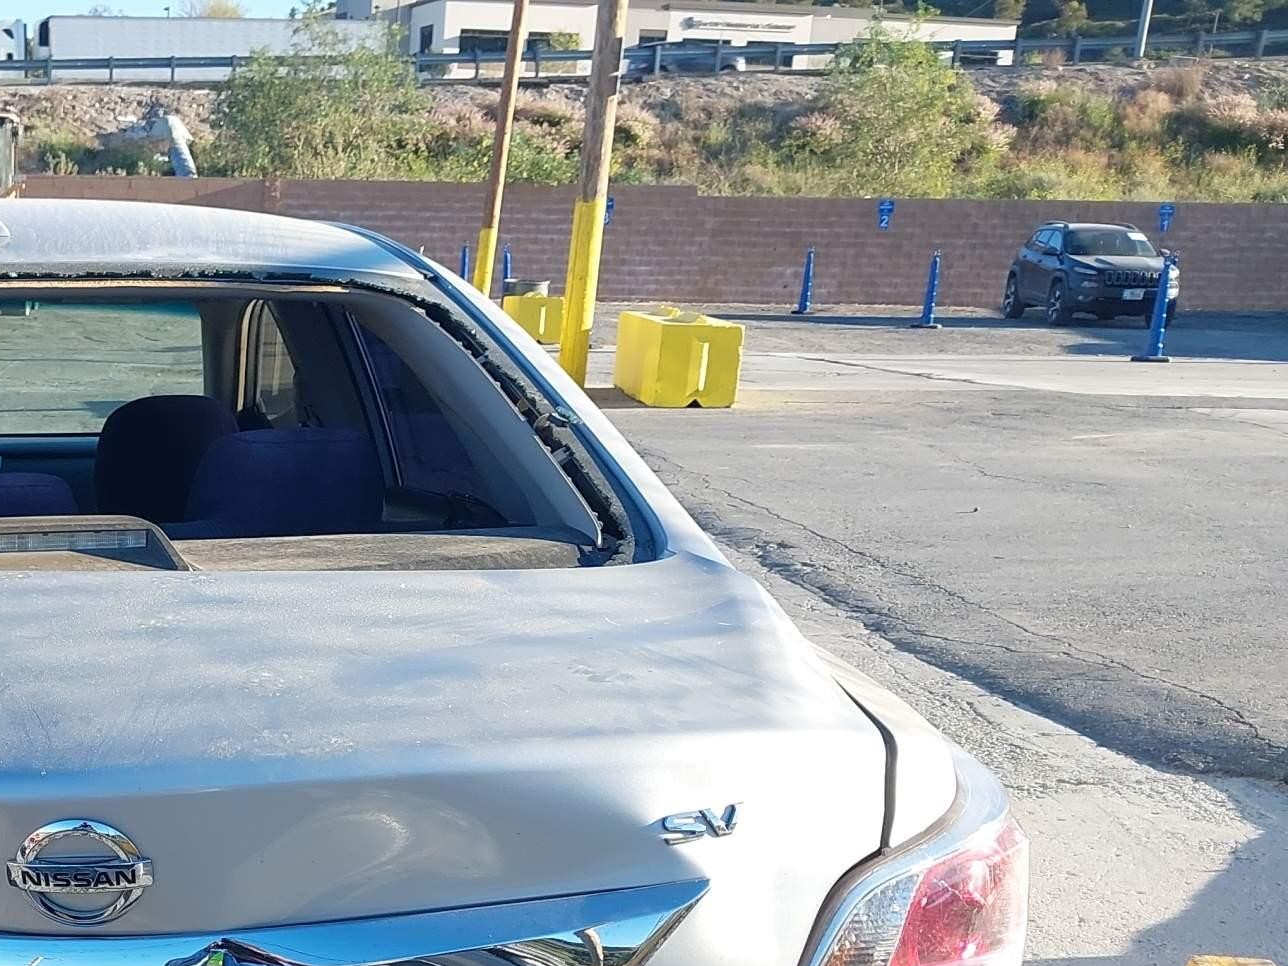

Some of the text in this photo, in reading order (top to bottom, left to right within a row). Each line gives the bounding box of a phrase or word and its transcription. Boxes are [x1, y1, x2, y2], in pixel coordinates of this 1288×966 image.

[880, 215, 888, 227] 2
[1162, 220, 1168, 231] 1
[662, 804, 737, 846] SV
[20, 868, 138, 888] NISSAN
